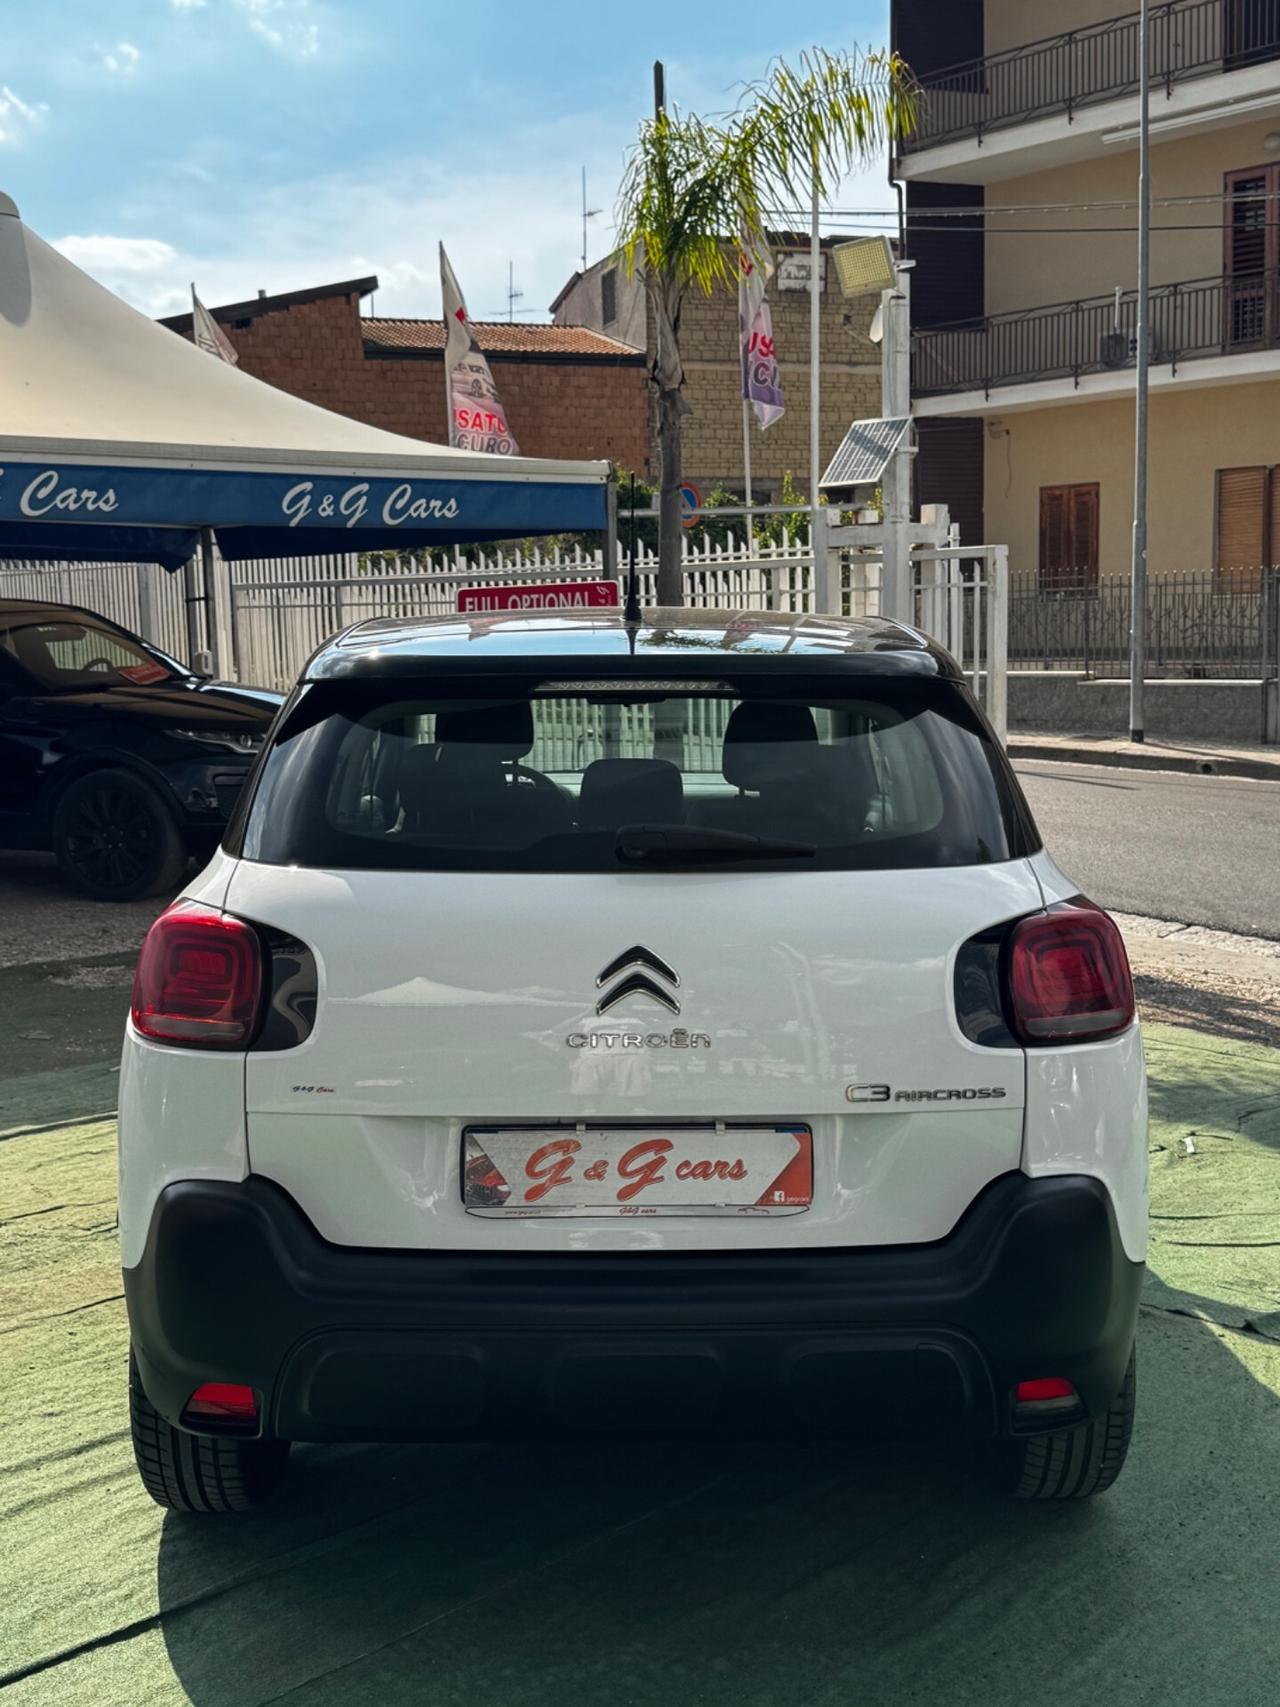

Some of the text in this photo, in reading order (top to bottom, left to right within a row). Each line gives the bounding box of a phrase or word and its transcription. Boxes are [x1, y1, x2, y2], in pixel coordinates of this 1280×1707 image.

[20, 470, 119, 516] Cars
[382, 483, 460, 526] Cars
[508, 591, 589, 610] OPTIONAL
[846, 1083, 1006, 1103] C3 AIRCROSS
[674, 1158, 748, 1181] cars
